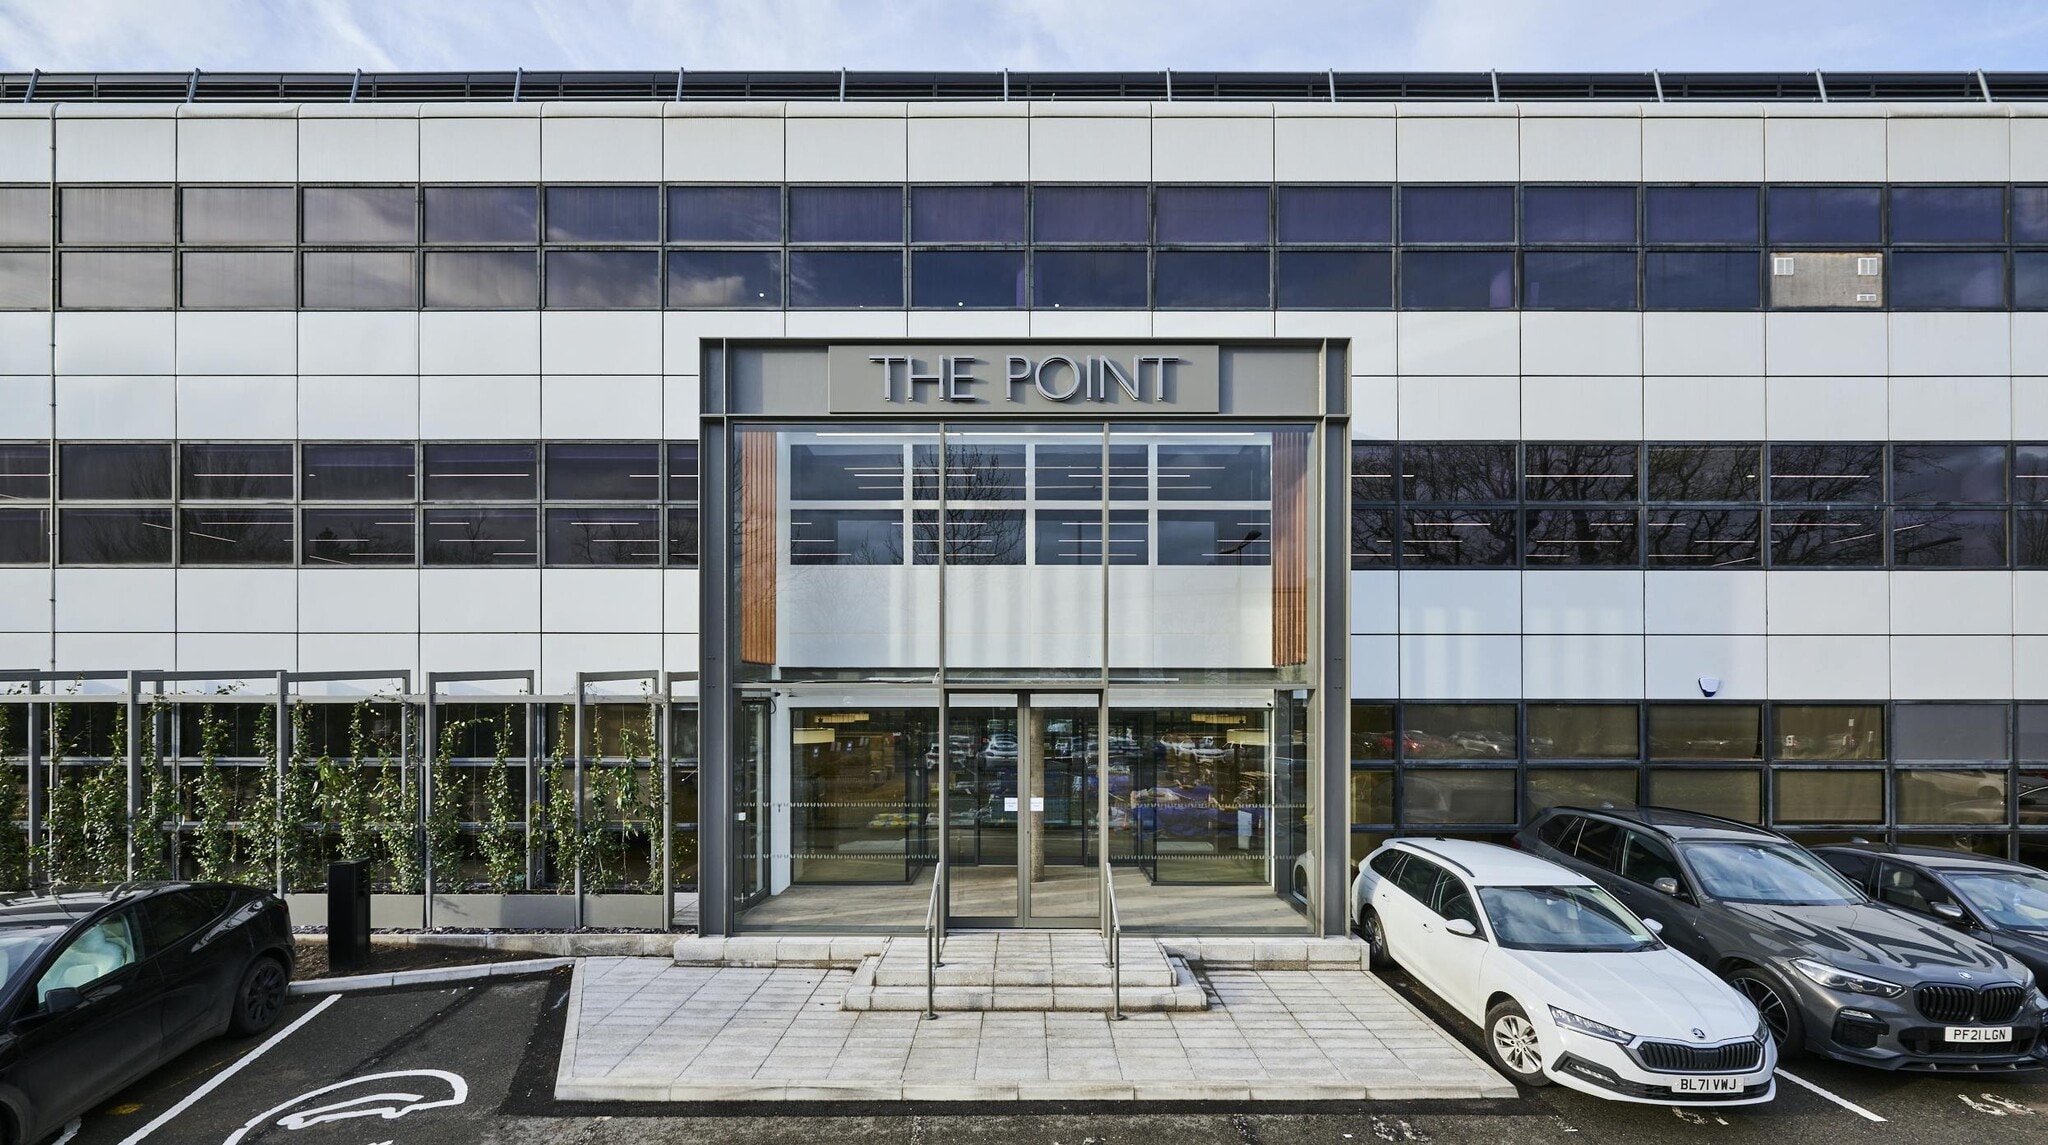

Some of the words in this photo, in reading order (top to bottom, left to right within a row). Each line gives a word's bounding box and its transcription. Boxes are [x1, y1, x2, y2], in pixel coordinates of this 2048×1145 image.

[869, 354, 976, 402] THE
[1006, 354, 1180, 402] POINT
[1953, 1029, 1982, 1041] PF21
[1984, 1029, 2006, 1041] LGN
[1680, 1078, 1710, 1091] BL71
[1713, 1078, 1737, 1091] VWJ
